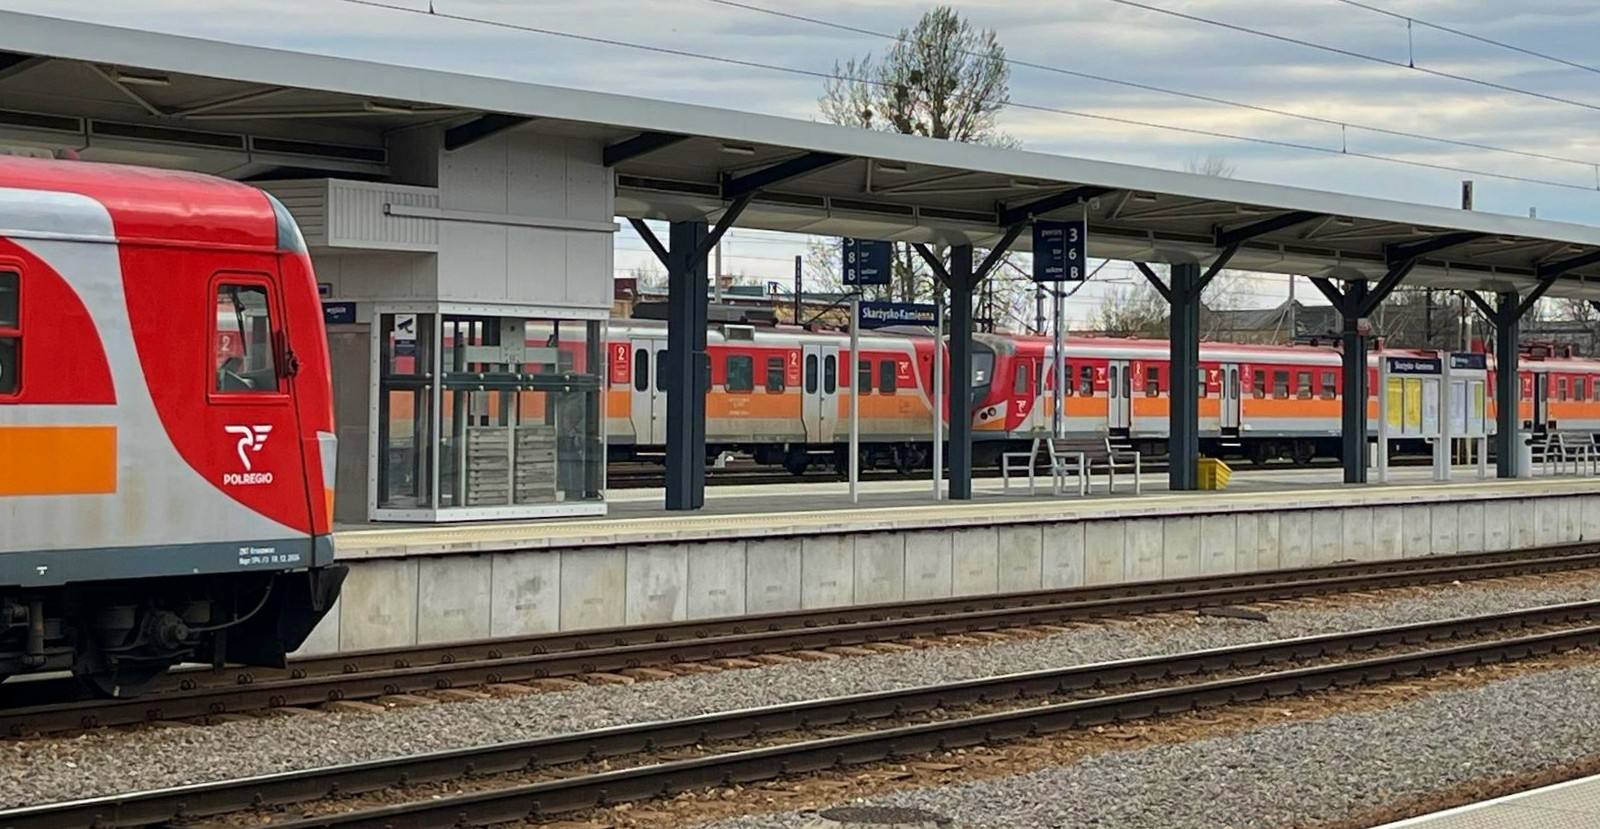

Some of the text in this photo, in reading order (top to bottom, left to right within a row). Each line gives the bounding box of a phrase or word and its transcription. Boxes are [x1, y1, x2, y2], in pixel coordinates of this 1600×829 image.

[1069, 228, 1078, 242] 3
[848, 252, 856, 264] 8
[1068, 248, 1077, 260] 6
[848, 269, 856, 281] B
[1070, 266, 1079, 279] B
[222, 336, 230, 351] 2
[618, 346, 625, 361] 2
[791, 351, 797, 366] 2
[223, 472, 273, 485] POLREGIO
